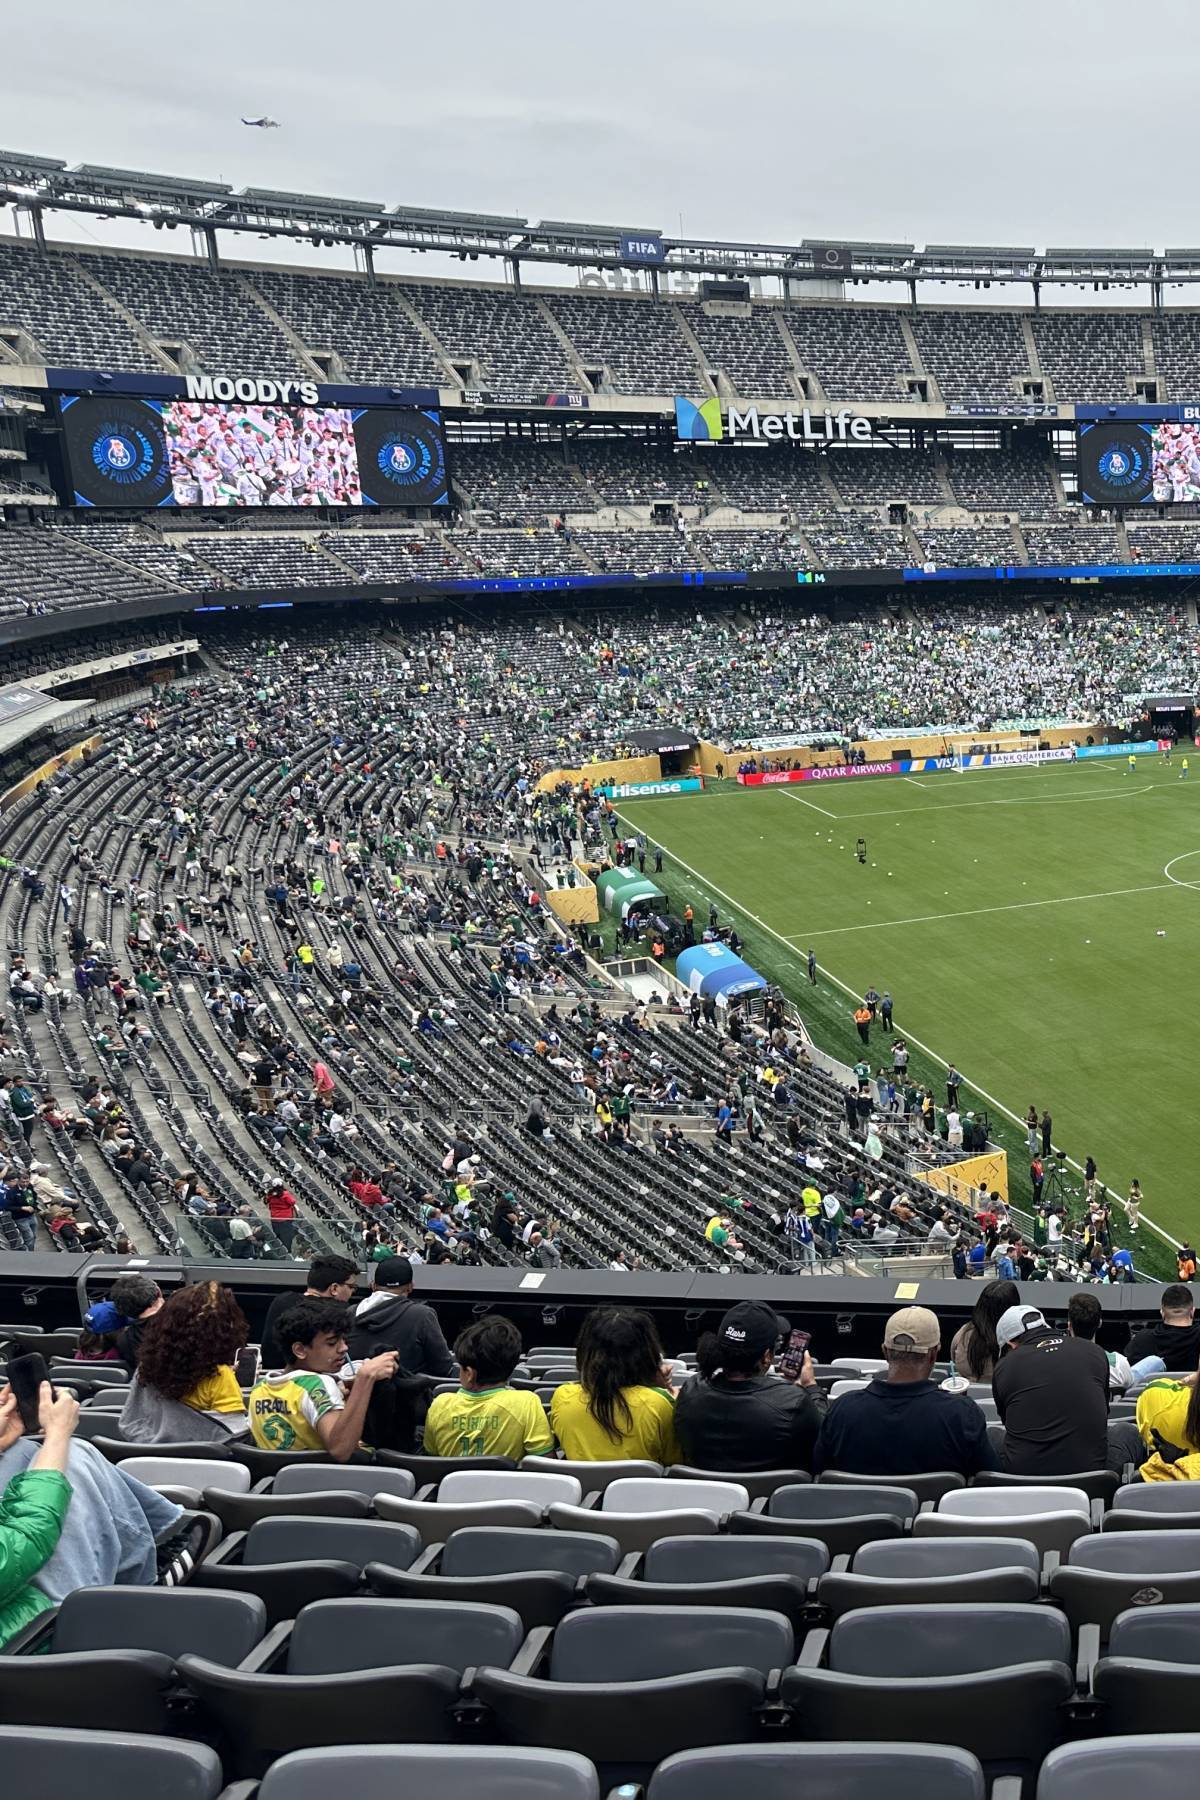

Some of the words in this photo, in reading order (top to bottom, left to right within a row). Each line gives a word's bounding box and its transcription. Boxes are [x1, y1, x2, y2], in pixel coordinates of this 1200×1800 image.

[628, 241, 657, 255] FIFA
[185, 376, 319, 405] MOODY'S
[728, 406, 872, 440] MetLife
[934, 757, 960, 769] VISA
[992, 753, 1015, 763] BANK
[1028, 750, 1066, 760] AMERICA
[762, 772, 790, 784] Coca-Cola
[812, 766, 846, 780] QATAR
[850, 763, 892, 775] AIRWAYS
[612, 781, 681, 798] Hisense
